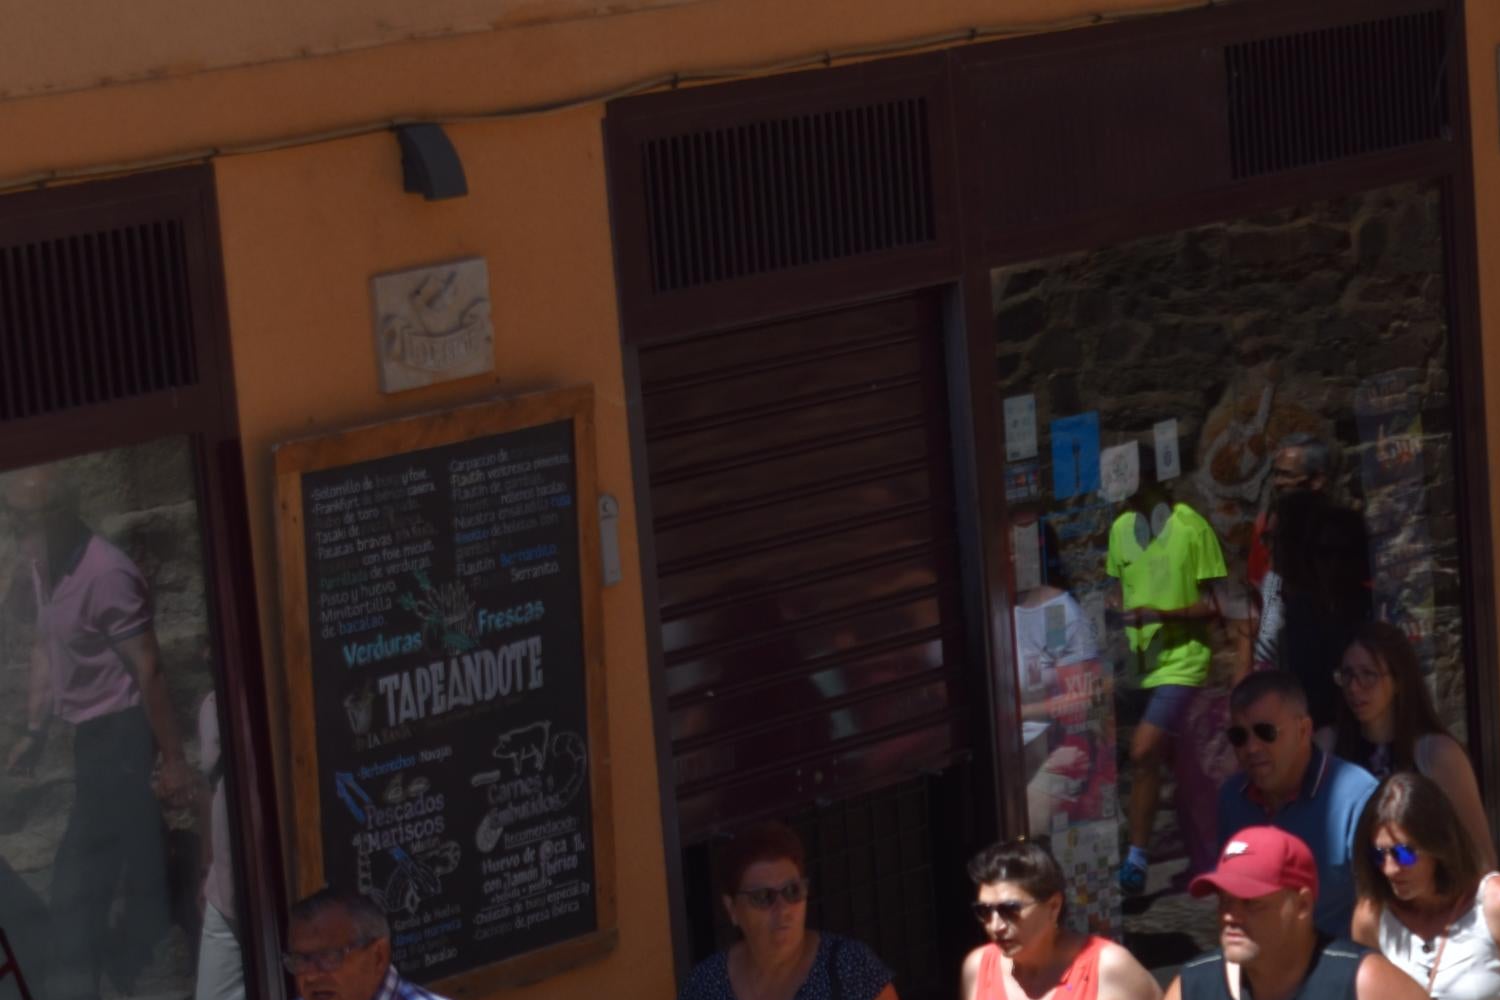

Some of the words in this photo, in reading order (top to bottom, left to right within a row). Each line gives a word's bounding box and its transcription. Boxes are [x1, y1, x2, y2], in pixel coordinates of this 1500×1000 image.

[356, 533, 393, 552] bravas
[343, 631, 423, 668] Verduras
[477, 600, 545, 634] Frescas
[379, 635, 544, 727] TAPEANDOTE
[365, 791, 445, 830] Pescados
[367, 815, 446, 854] Mariscos
